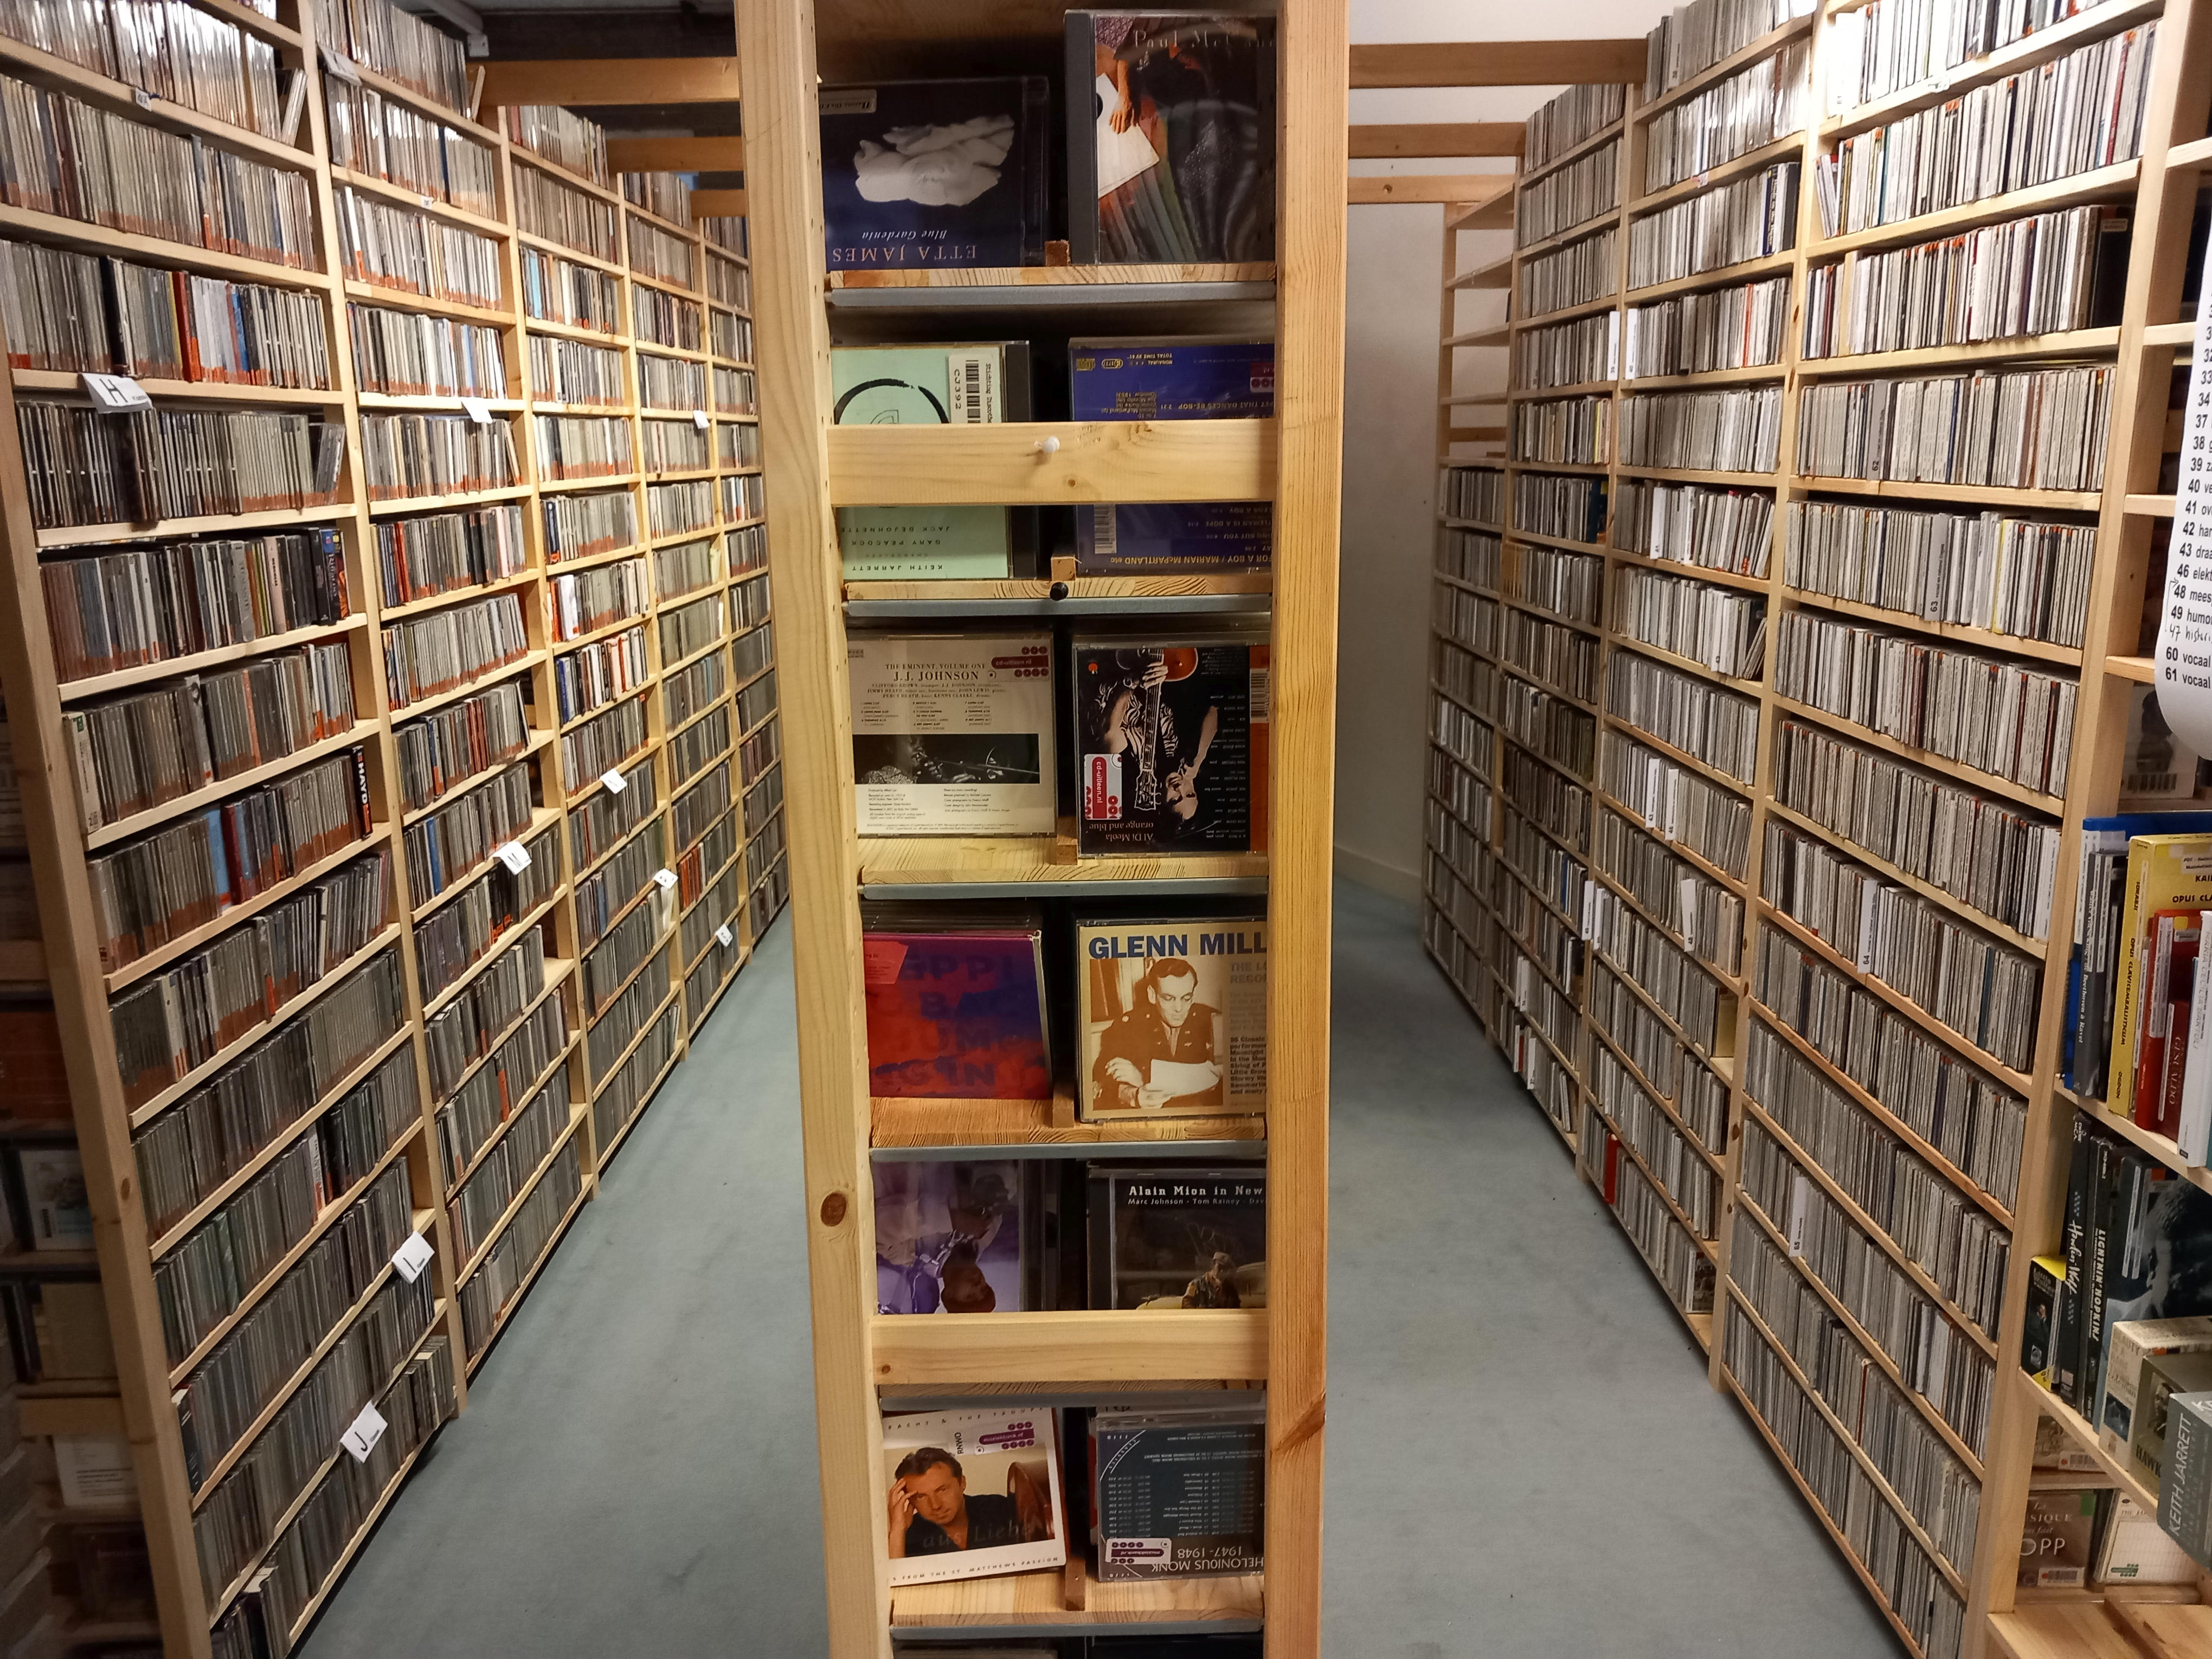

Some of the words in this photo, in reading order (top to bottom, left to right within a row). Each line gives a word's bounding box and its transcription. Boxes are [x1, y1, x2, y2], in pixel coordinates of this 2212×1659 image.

[1133, 30, 1176, 48] Paul
[861, 230, 917, 242] Gardenia
[921, 229, 948, 240] Blue
[833, 245, 906, 262] JAMES
[918, 245, 976, 260] ETTA
[99, 378, 128, 404] H
[2198, 392, 2210, 407] 34
[2196, 414, 2208, 428] 37
[2193, 436, 2205, 450] 38
[2191, 458, 2203, 472] 39
[2188, 479, 2200, 493] 40
[2185, 500, 2197, 515] 41
[2183, 521, 2195, 536] 42
[2179, 542, 2192, 557] 43
[1124, 556, 1181, 564] McPARTLAND
[1227, 555, 1245, 563] BOY
[2177, 563, 2190, 578] 46
[2174, 584, 2186, 599] 48
[2171, 605, 2183, 620] 49
[2170, 623, 2181, 641] 47
[2166, 646, 2178, 661] 60
[2183, 653, 2211, 668] vocaal
[918, 671, 979, 681] JOHNSON
[2165, 667, 2177, 681] 61
[2182, 674, 2211, 689] vocaal
[1089, 823, 1107, 831] blue
[1109, 822, 1123, 831] and
[1105, 833, 1130, 841] Meola
[2172, 895, 2195, 903] OPUS
[1089, 934, 1188, 960] GLENN
[1200, 932, 1266, 956] MILL
[1231, 962, 1252, 972] THE
[1129, 1186, 1166, 1195] Alain
[1173, 1186, 1206, 1195] Mion
[1214, 1186, 1227, 1195] in
[1234, 1185, 1263, 1195] New
[2092, 1288, 2102, 1342] HOPKINS
[354, 1431, 368, 1452] J
[983, 1432, 1024, 1443] muziekbank.nl
[2175, 1412, 2191, 1485] JARRETT
[2169, 1483, 2184, 1536] KEITH
[923, 1532, 963, 1548] aus
[969, 1562, 1016, 1573] MATTHEWS
[1021, 1556, 1059, 1566] PASSION
[1151, 1560, 1191, 1573] MONK
[1195, 1557, 1264, 1570] HELONIOUS
